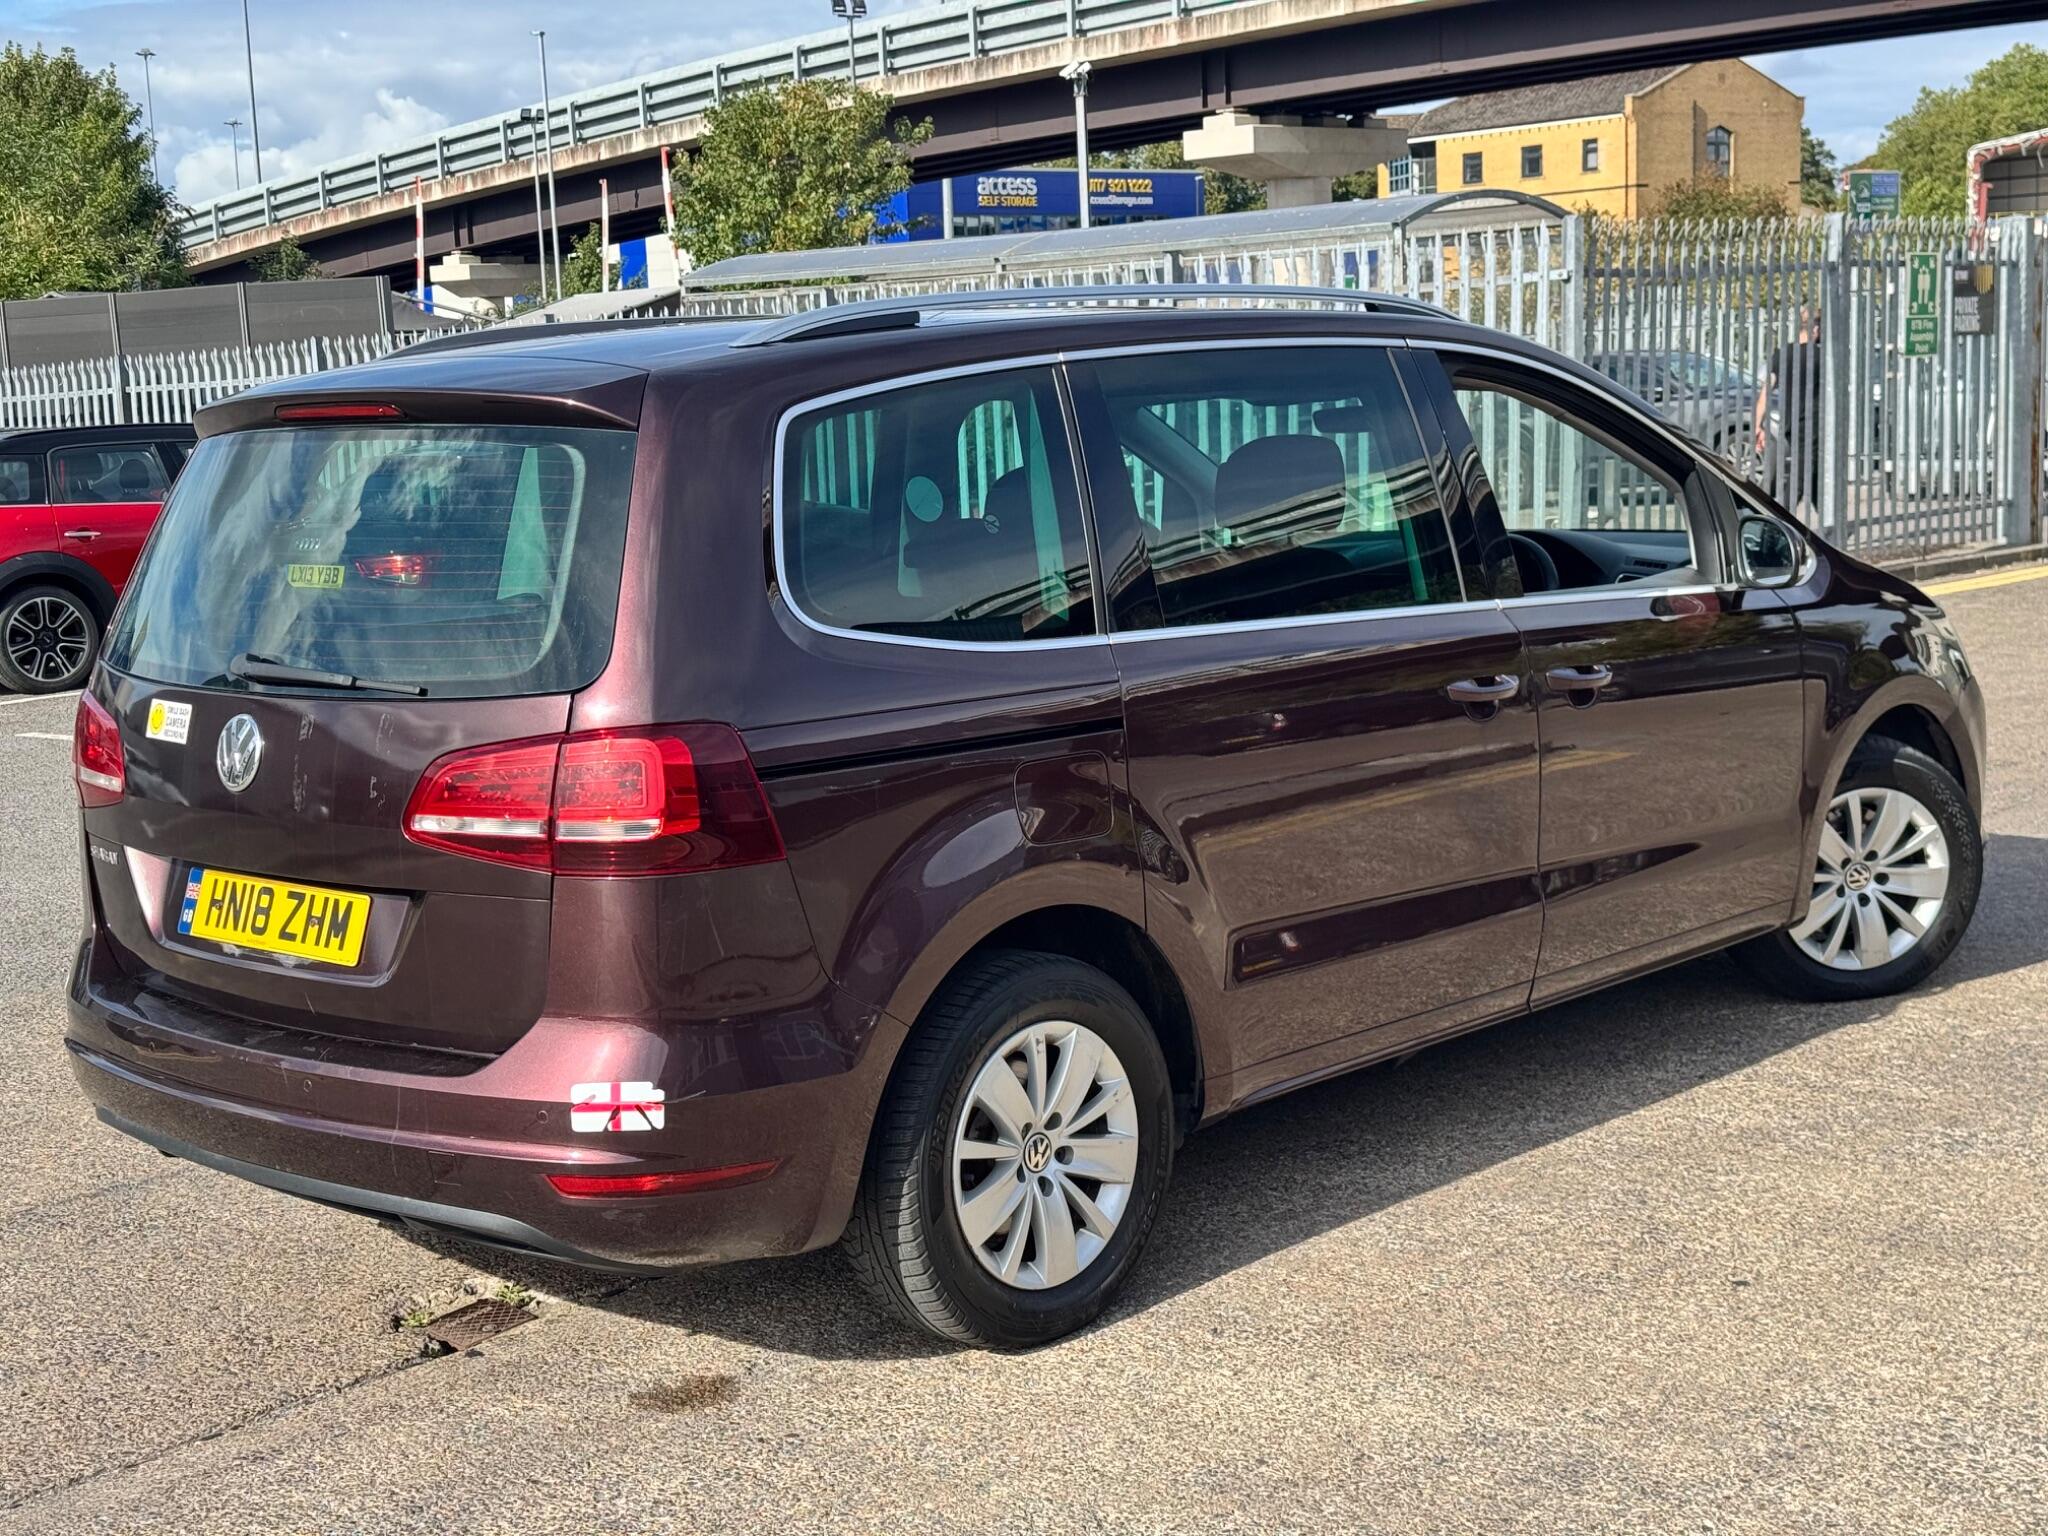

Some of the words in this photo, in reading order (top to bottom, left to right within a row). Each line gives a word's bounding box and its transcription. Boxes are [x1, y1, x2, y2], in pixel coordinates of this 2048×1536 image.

[977, 176, 1038, 195] access
[978, 196, 1000, 207] SELF
[1000, 196, 1038, 207] STORAGE
[165, 716, 187, 729] CAMERA
[182, 908, 194, 923] GB
[204, 878, 275, 936] HN18
[278, 890, 353, 952] ZHM
